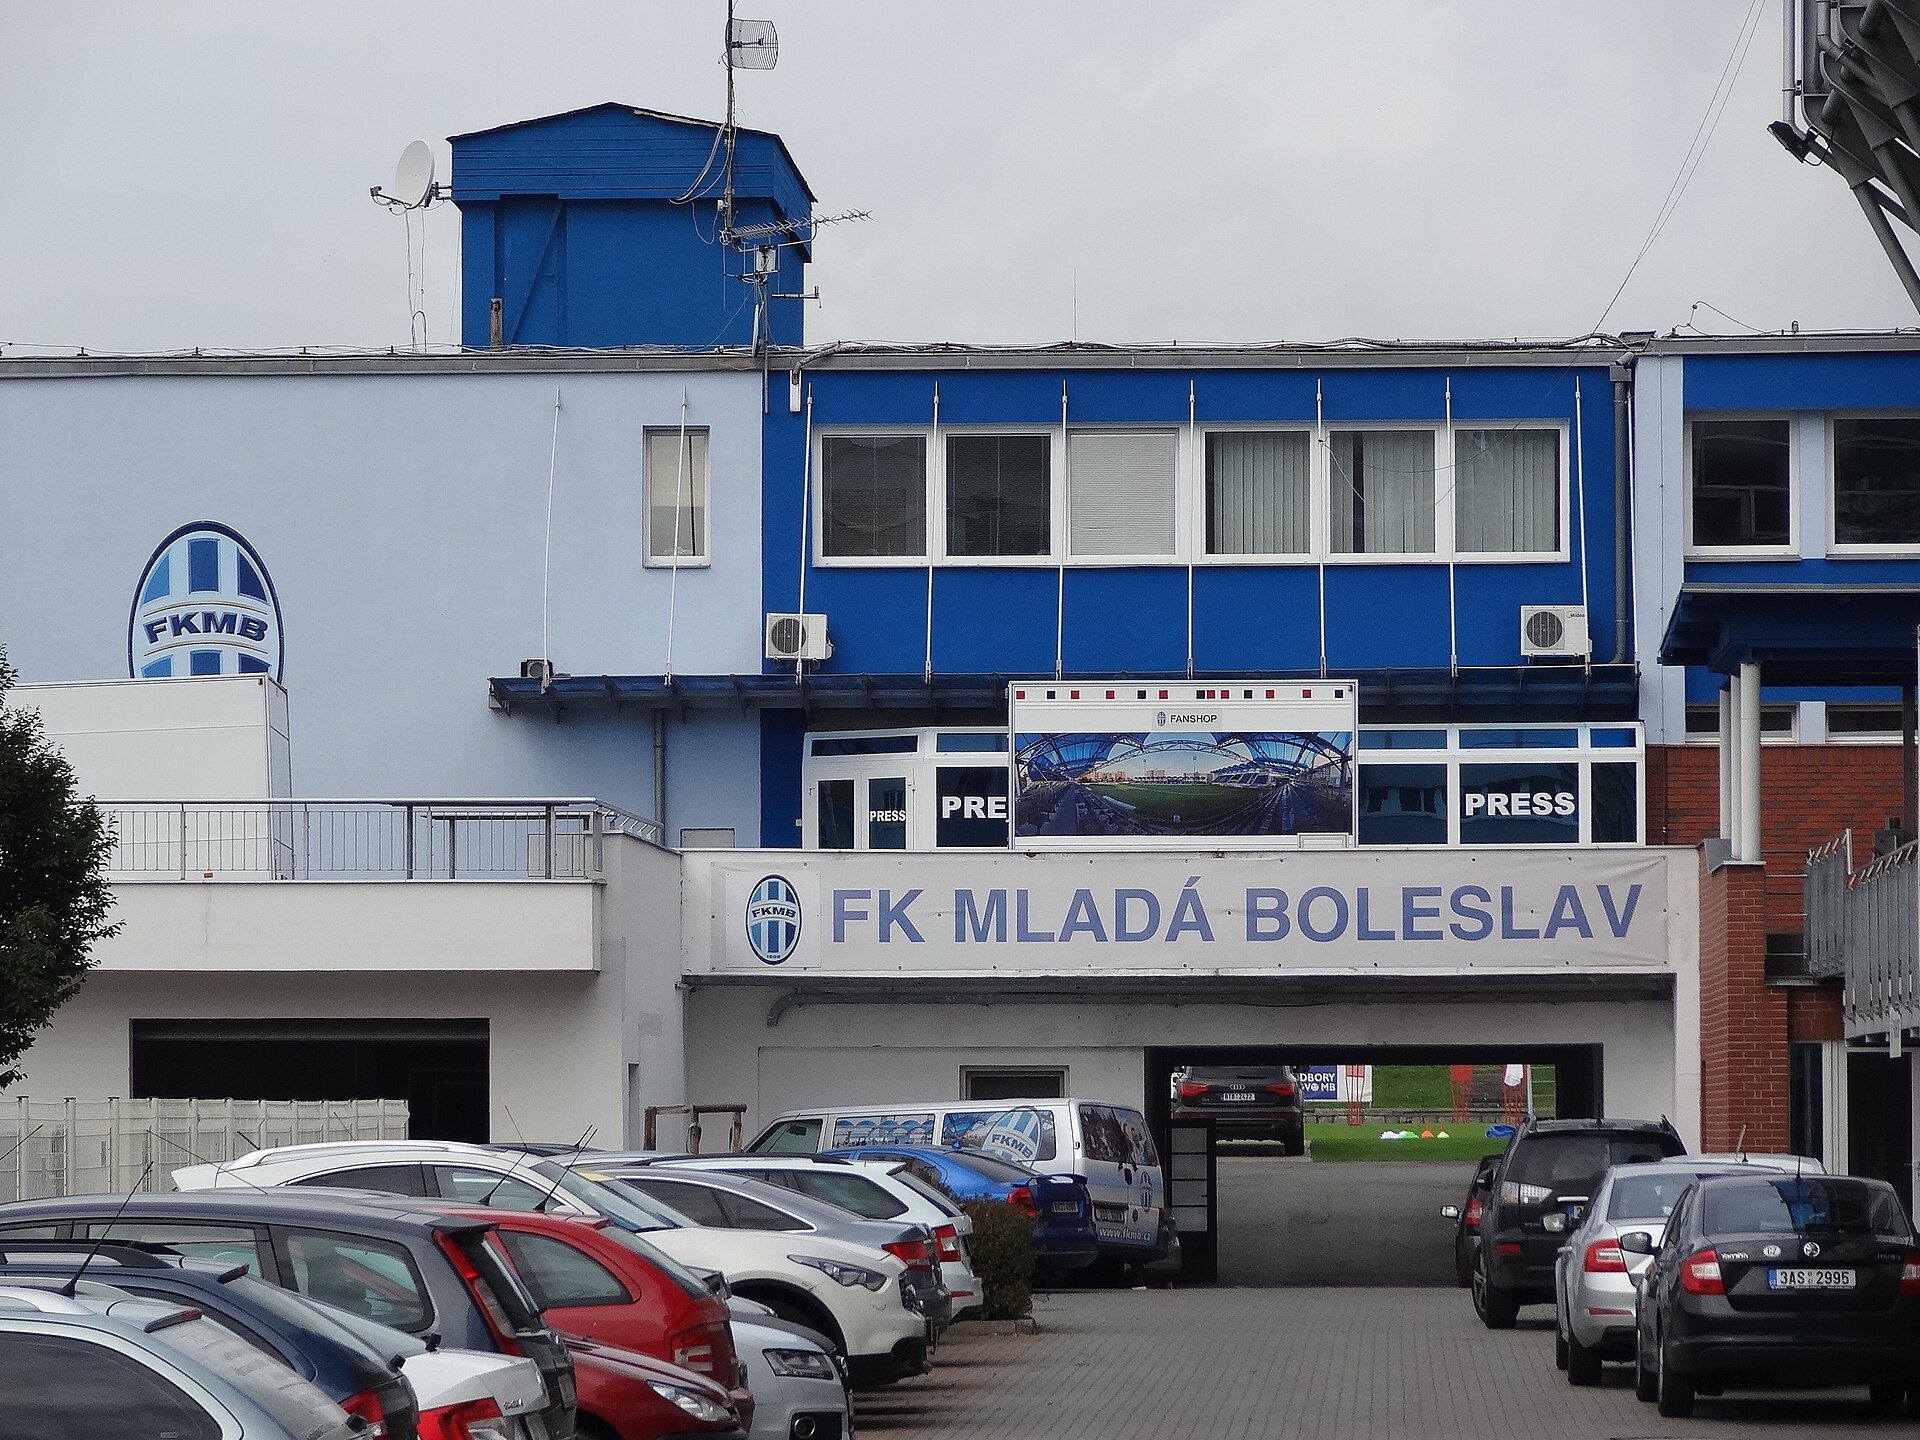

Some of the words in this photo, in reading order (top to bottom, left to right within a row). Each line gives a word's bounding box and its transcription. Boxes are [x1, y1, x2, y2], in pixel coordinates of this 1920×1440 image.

[143, 611, 269, 645] FKMB
[1170, 714, 1218, 723] FANSHOP
[941, 795, 1008, 819] PRE
[1465, 791, 1576, 816] PRESS
[869, 809, 907, 822] PRESS
[751, 906, 797, 918] FKMB
[832, 888, 926, 943] FK
[953, 875, 1216, 943] MLADÁ
[1245, 883, 1643, 943] BOLESLAV
[1299, 1073, 1336, 1082] DBORY
[1321, 1083, 1336, 1092] MB
[991, 1133, 1033, 1159] FKMB
[1100, 1226, 1151, 1240] www.fkmb.cz
[1780, 1271, 1805, 1285] 3AS
[1816, 1271, 1850, 1285] 2995
